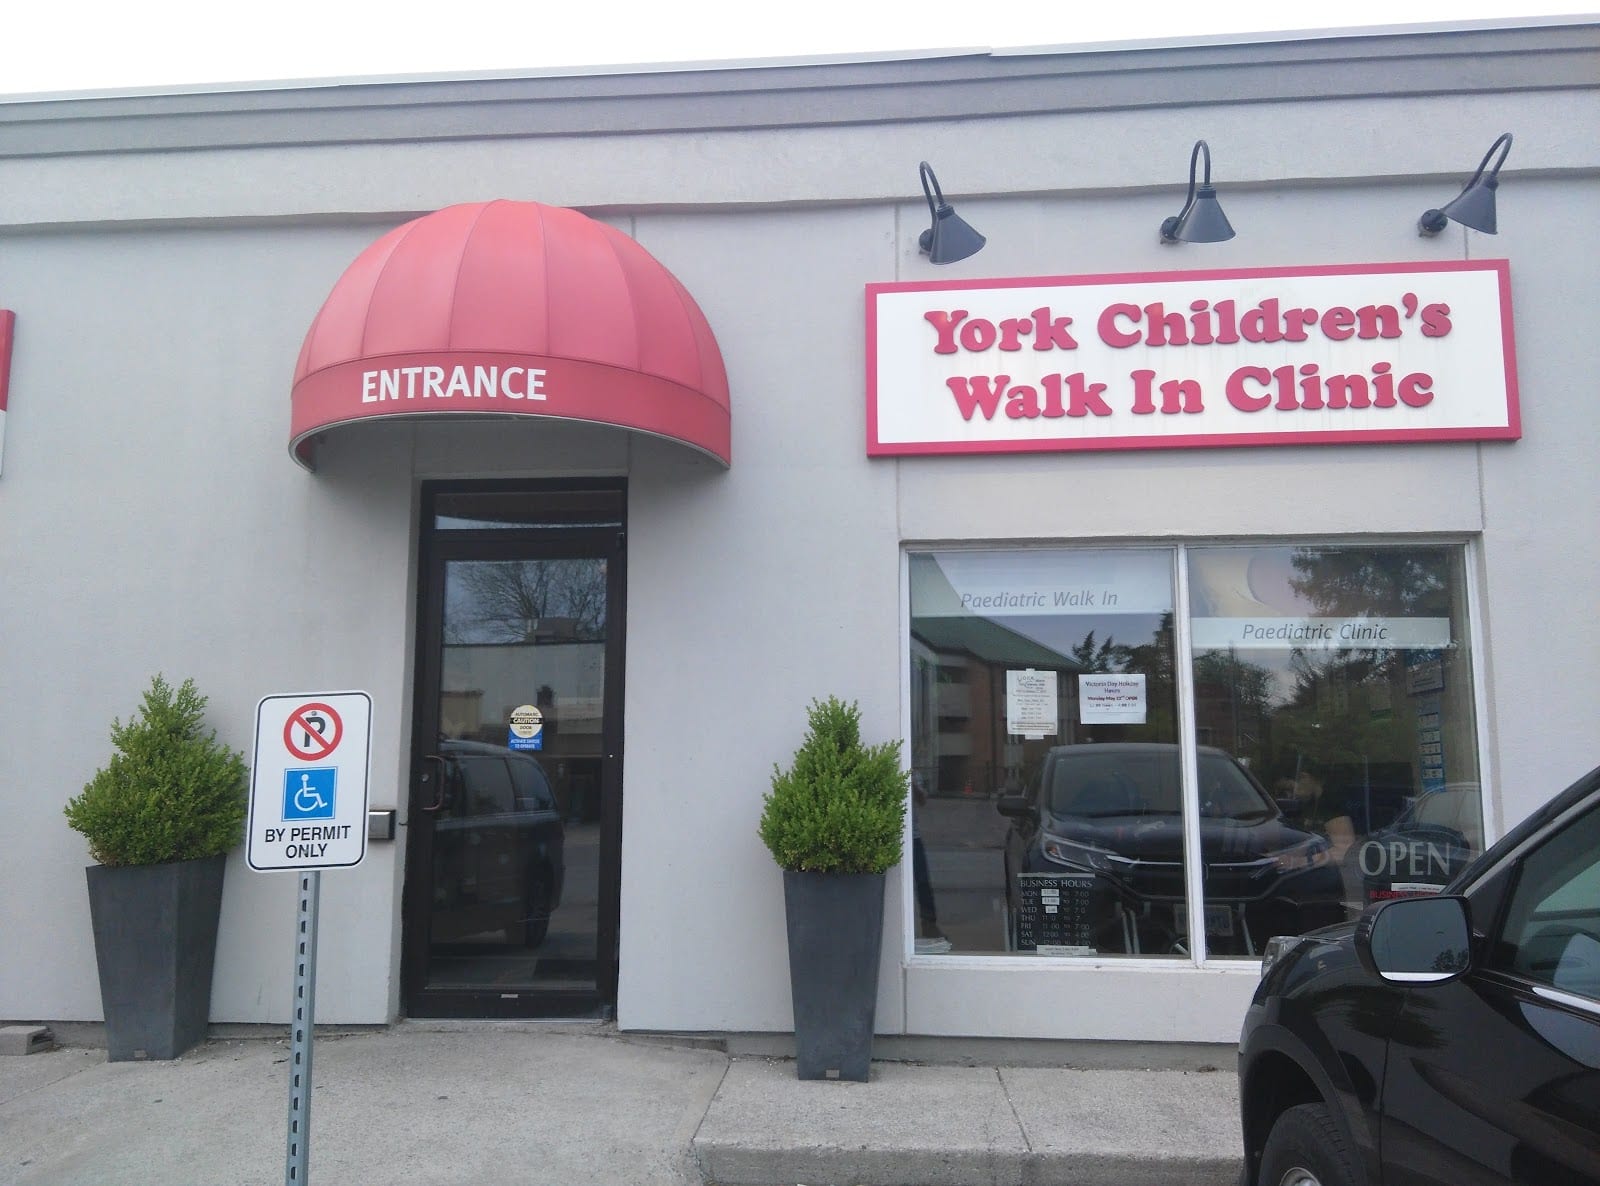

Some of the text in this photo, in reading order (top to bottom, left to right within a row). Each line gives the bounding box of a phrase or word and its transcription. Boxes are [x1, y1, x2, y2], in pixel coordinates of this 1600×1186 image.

[924, 292, 1452, 355] York Children's
[362, 365, 547, 404] ENTRANCE
[946, 362, 1434, 421] Walk In Clinic
[961, 590, 1118, 608] Paediatric Walk In
[1242, 623, 1388, 640] Paediatric Clinic
[265, 825, 351, 843] BY PERMIT
[285, 843, 328, 859] ONLY
[1358, 840, 1450, 876] OPEN
[1020, 880, 1093, 888] BUSINESS HOURS
